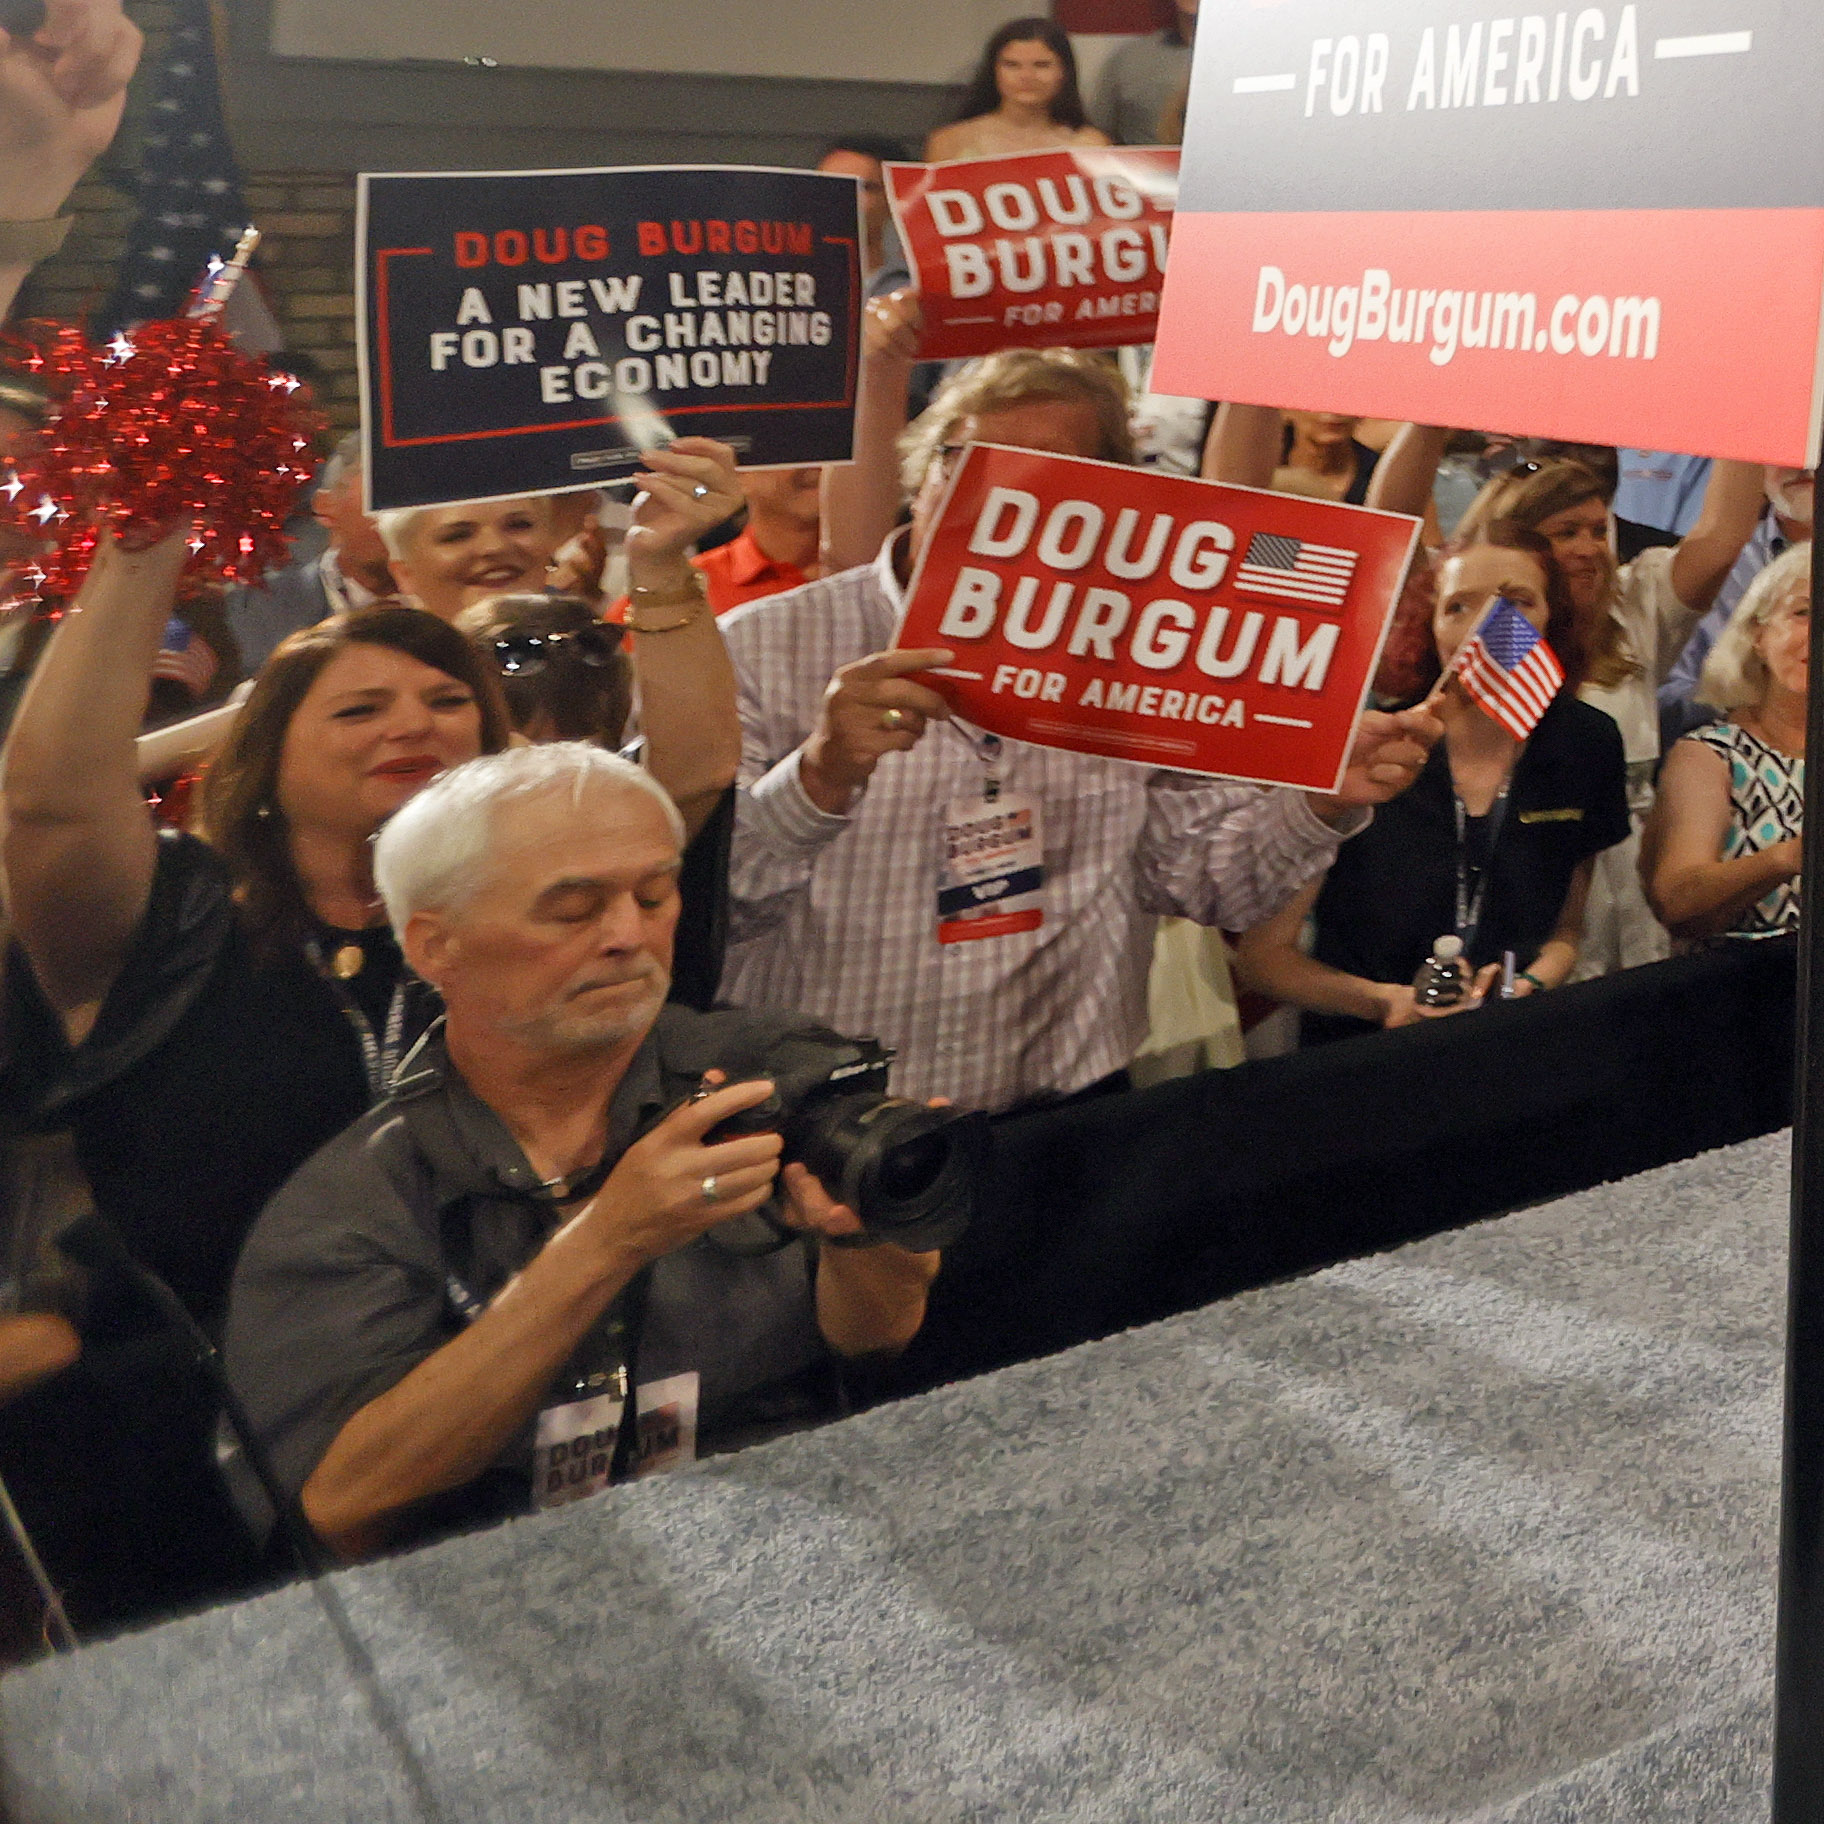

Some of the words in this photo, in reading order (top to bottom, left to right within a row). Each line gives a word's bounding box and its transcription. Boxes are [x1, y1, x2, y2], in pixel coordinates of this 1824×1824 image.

[1305, 32, 1384, 117] FOR
[1407, 3, 1640, 111] AMERICA
[925, 174, 1144, 237] DOUG
[454, 225, 611, 269] DOUG
[636, 219, 814, 257] BURGUM
[943, 224, 1170, 299] BURG
[456, 286, 493, 326] A
[516, 275, 643, 323] NEW
[668, 270, 817, 309] LEADER
[1003, 301, 1064, 327] FOR
[1074, 291, 1162, 320] AMER
[1251, 264, 1662, 366] DougBurgum.com
[430, 326, 536, 372] FOR
[563, 321, 601, 360] A
[625, 310, 833, 353] CHANGING
[540, 349, 773, 405] ECONOMY
[968, 486, 1236, 591] DOUG
[938, 565, 1341, 692] BURGUM
[991, 663, 1065, 705] FOR
[1079, 678, 1246, 729] AMERICA
